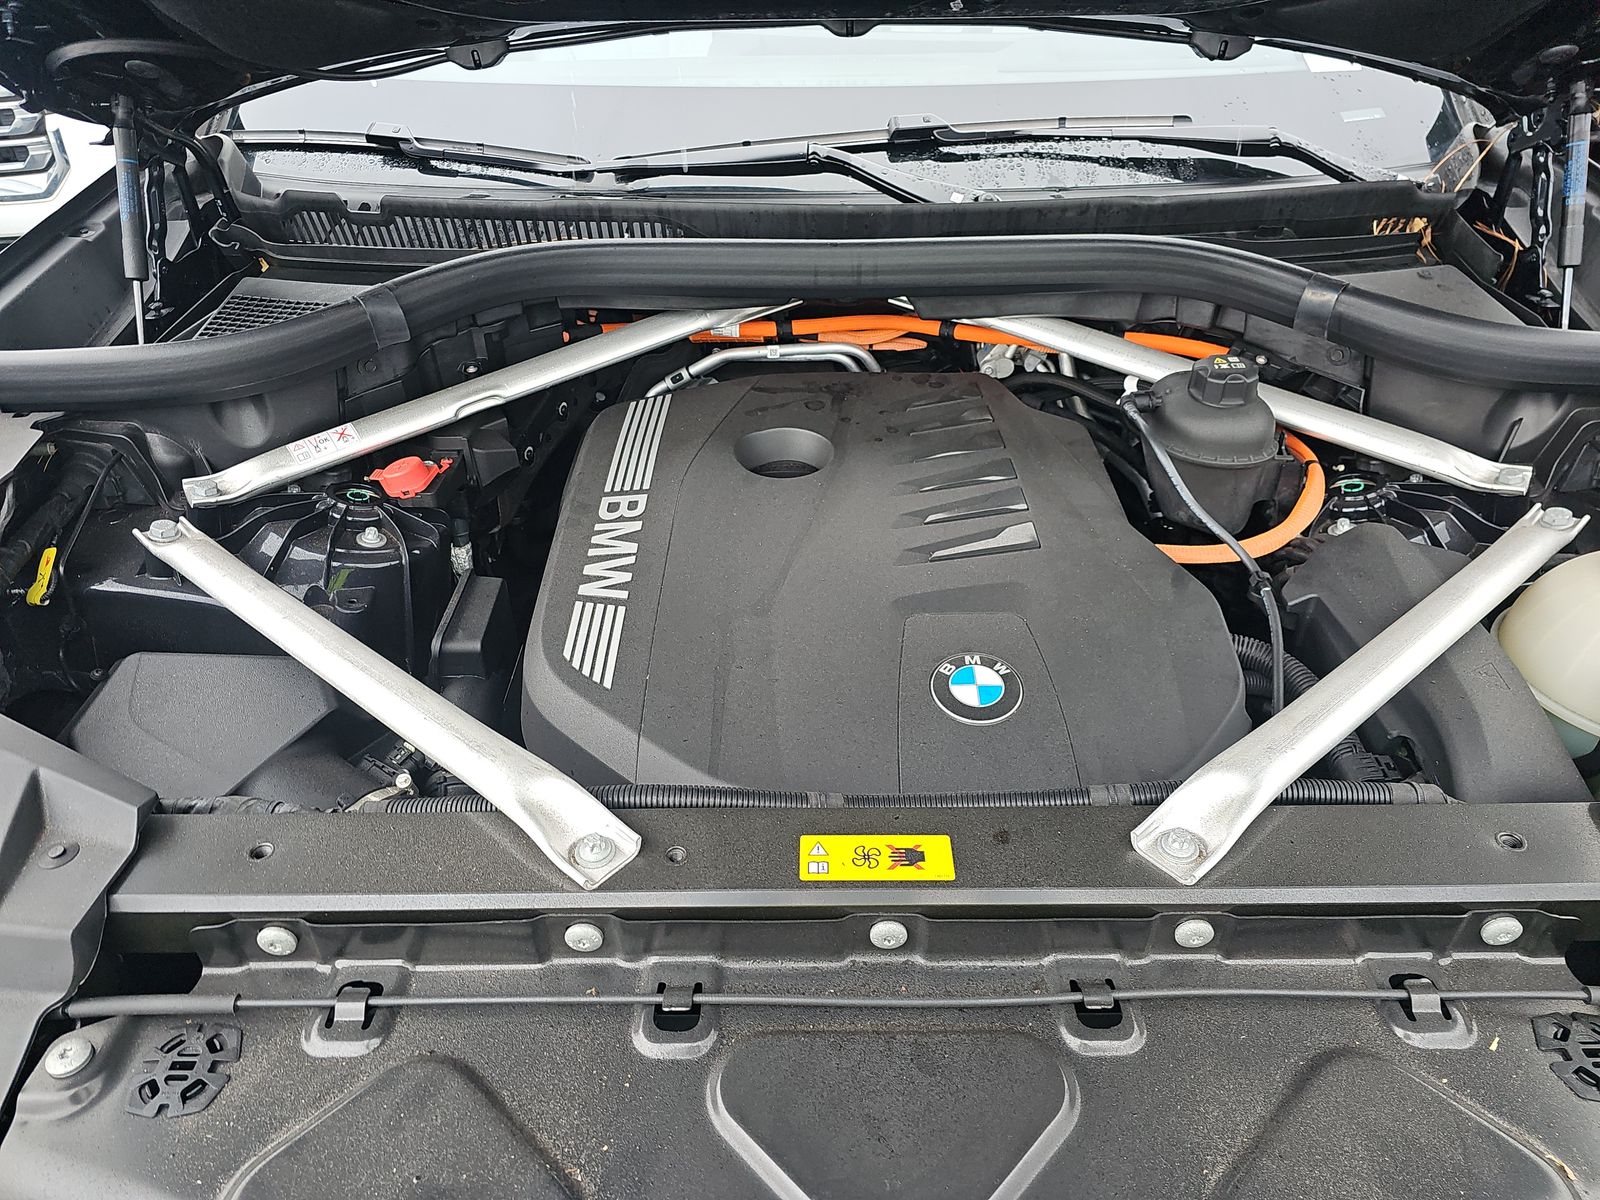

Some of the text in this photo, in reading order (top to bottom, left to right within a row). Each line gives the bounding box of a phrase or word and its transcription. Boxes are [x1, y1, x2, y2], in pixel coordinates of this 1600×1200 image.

[318, 437, 330, 445] OK
[577, 493, 649, 600] BMW
[939, 655, 1011, 676] BMW
